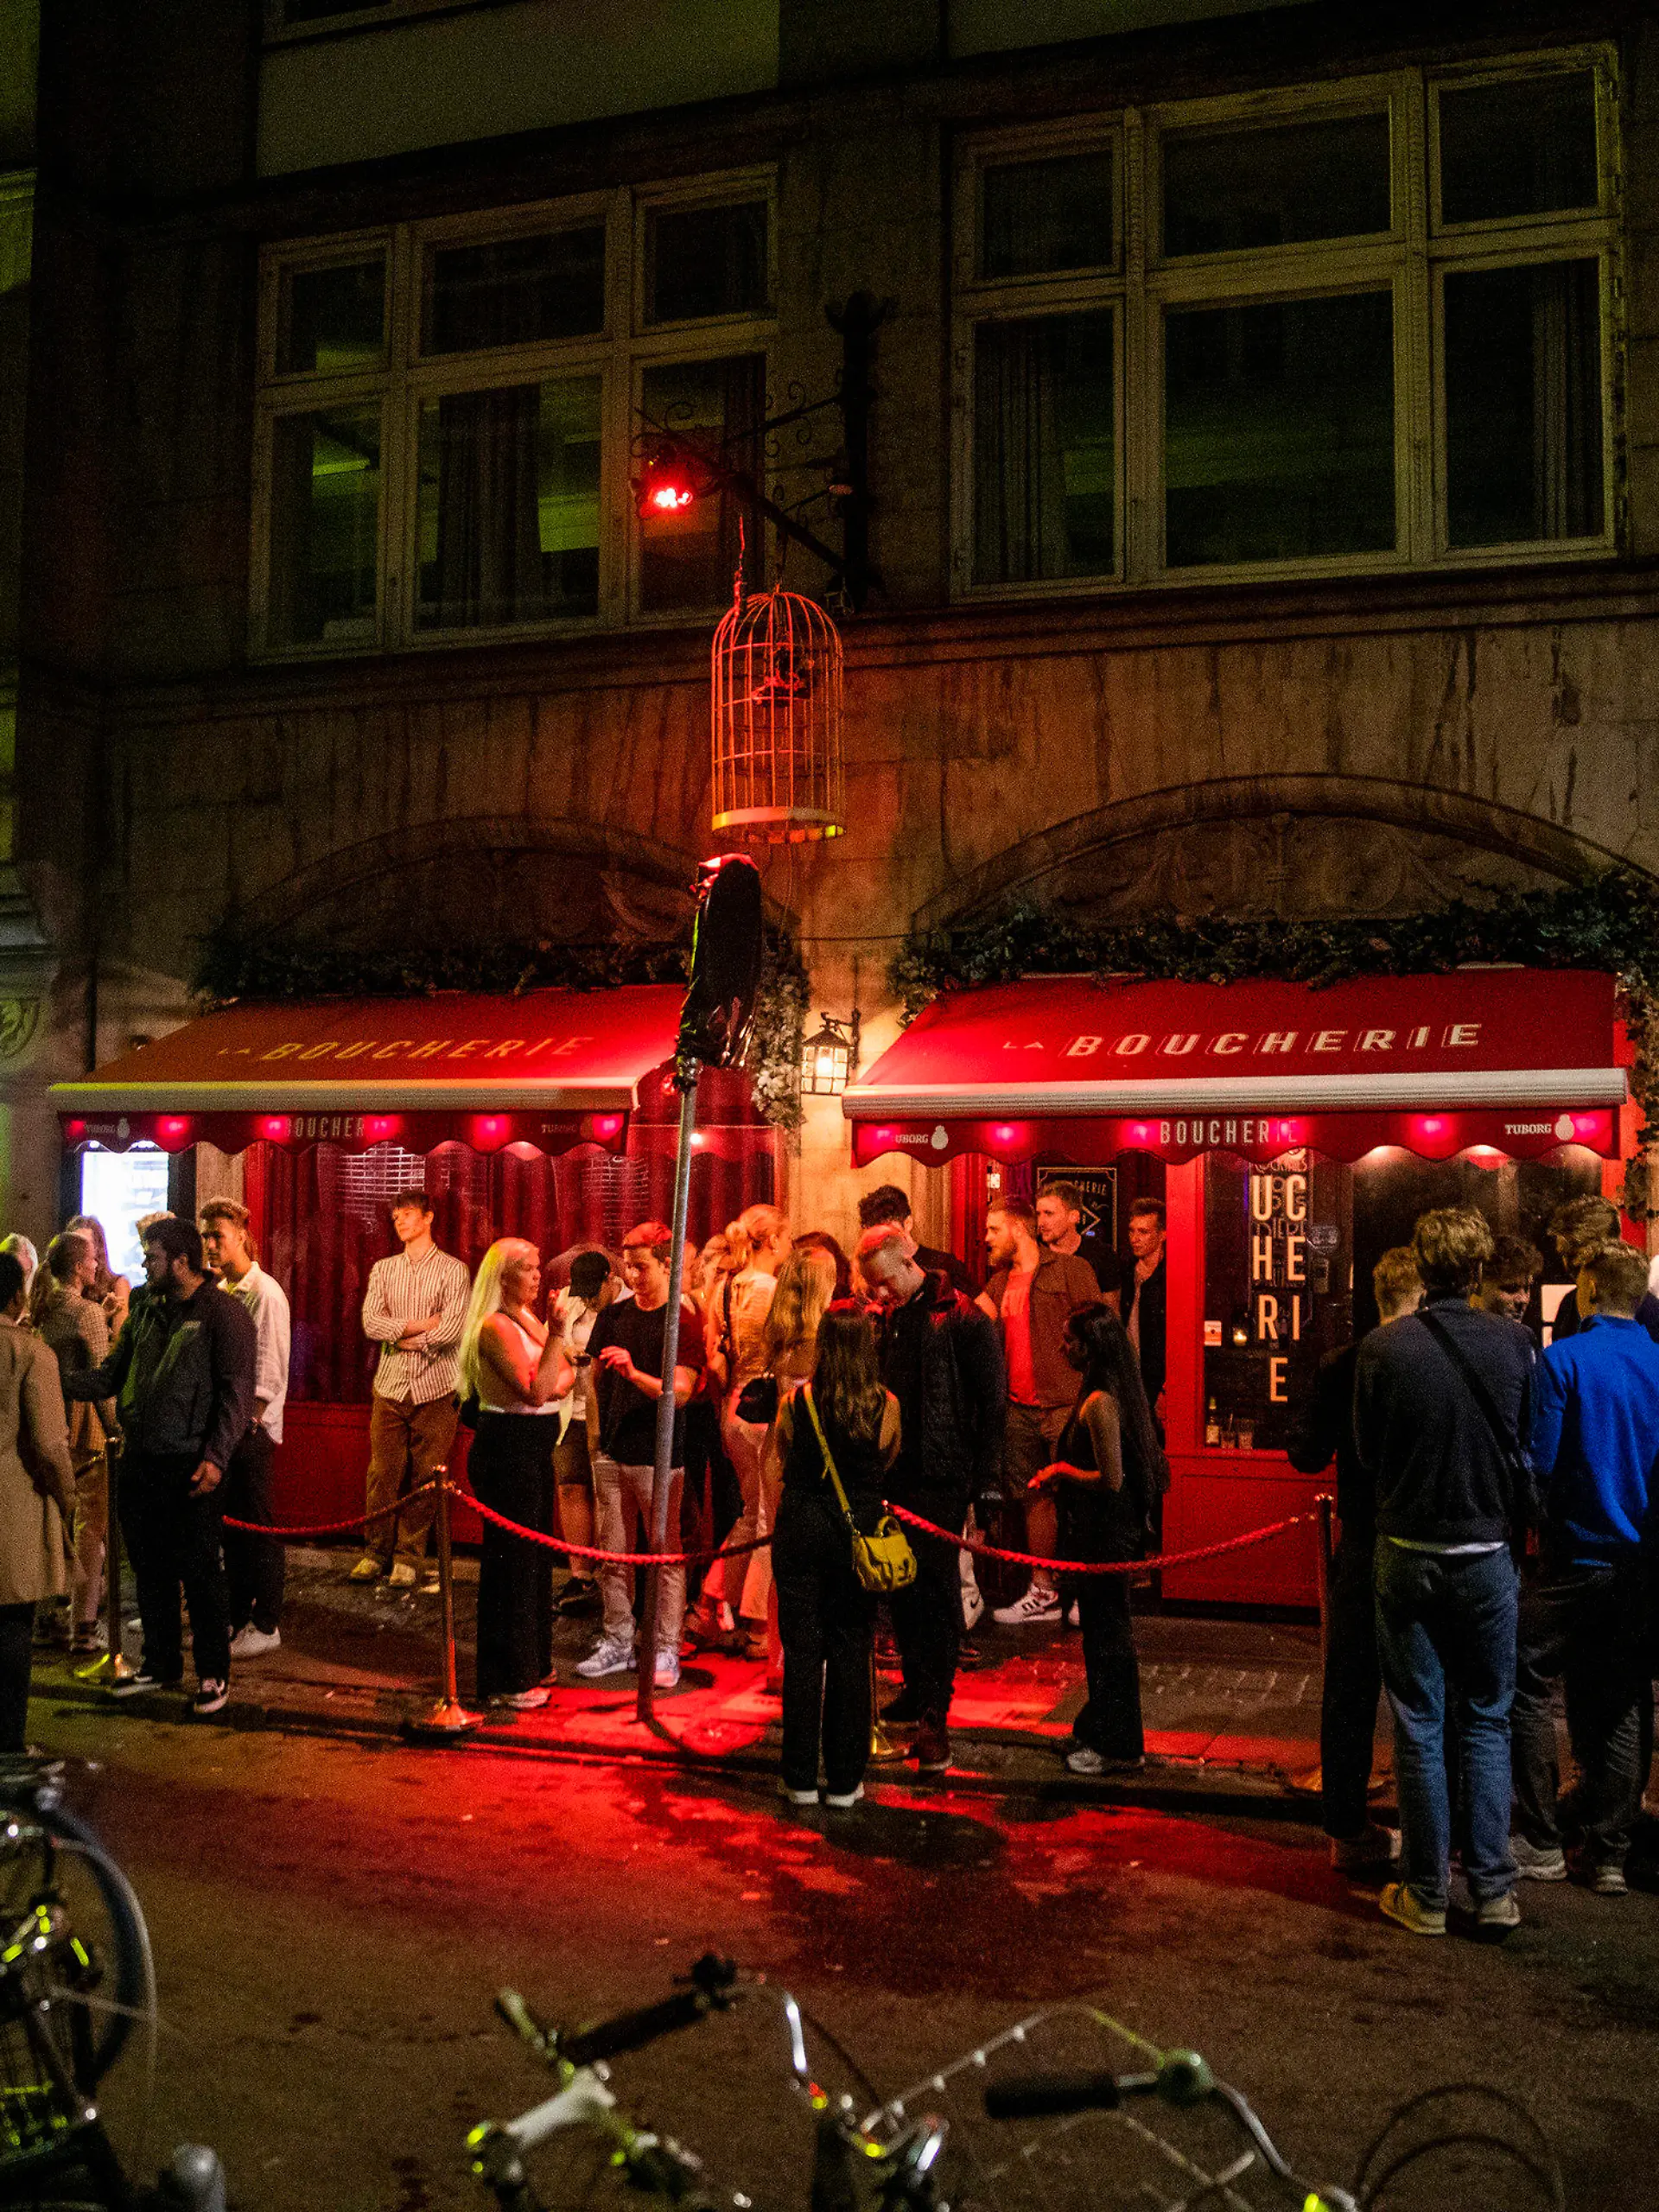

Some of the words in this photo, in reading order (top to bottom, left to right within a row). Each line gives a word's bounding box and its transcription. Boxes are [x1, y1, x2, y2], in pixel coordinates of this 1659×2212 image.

[260, 1037, 594, 1061] BOUCHERIE
[1003, 1040, 1044, 1050] LA
[1058, 1024, 1482, 1058] BOUCHERIE
[284, 1116, 365, 1139] BOUCHER
[891, 1134, 929, 1144] UBORG
[1160, 1120, 1298, 1144] BOUCHERIE
[1504, 1123, 1552, 1135] TUBORG
